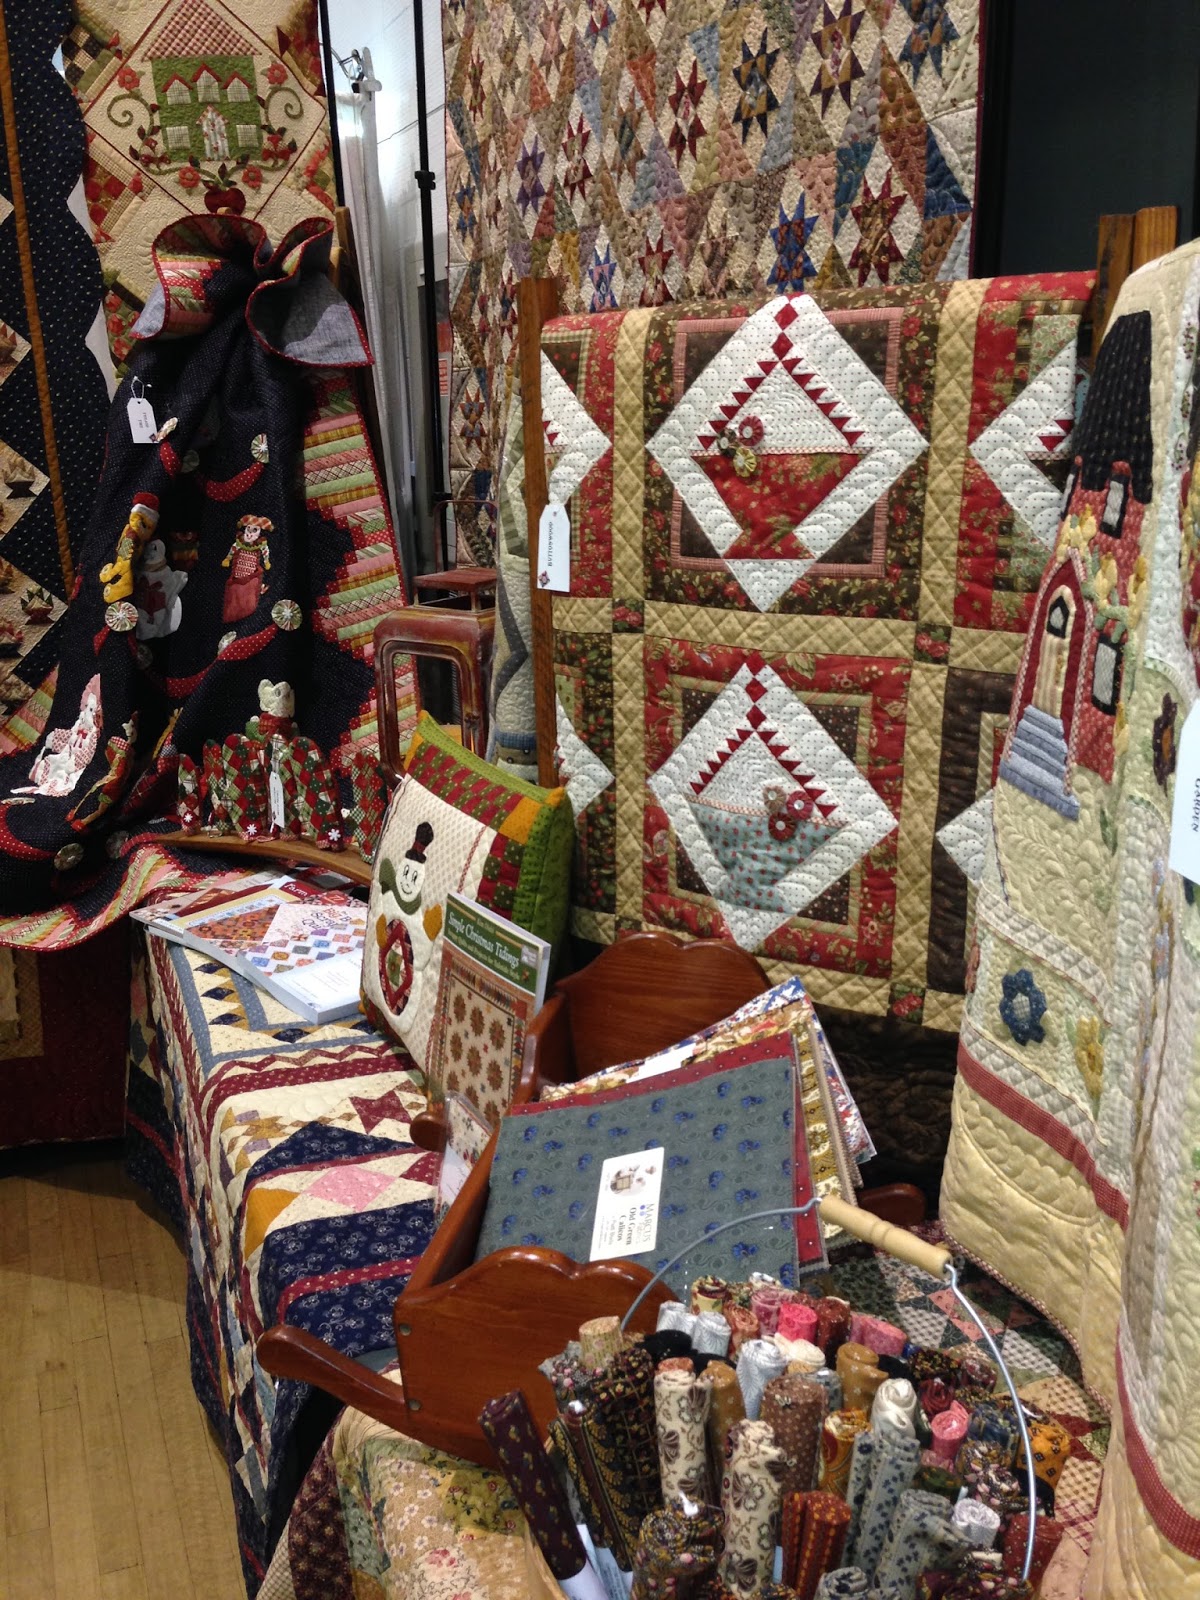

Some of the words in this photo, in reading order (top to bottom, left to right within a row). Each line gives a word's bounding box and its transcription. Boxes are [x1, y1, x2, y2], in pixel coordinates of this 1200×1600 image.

[448, 911, 465, 933] Simple
[465, 923, 494, 953] Christmas
[495, 942, 519, 969] Tidings
[628, 1207, 637, 1221] Old
[642, 1203, 655, 1242] MARCUS
[617, 1215, 627, 1241] Calicos
[626, 1222, 635, 1245] Green
